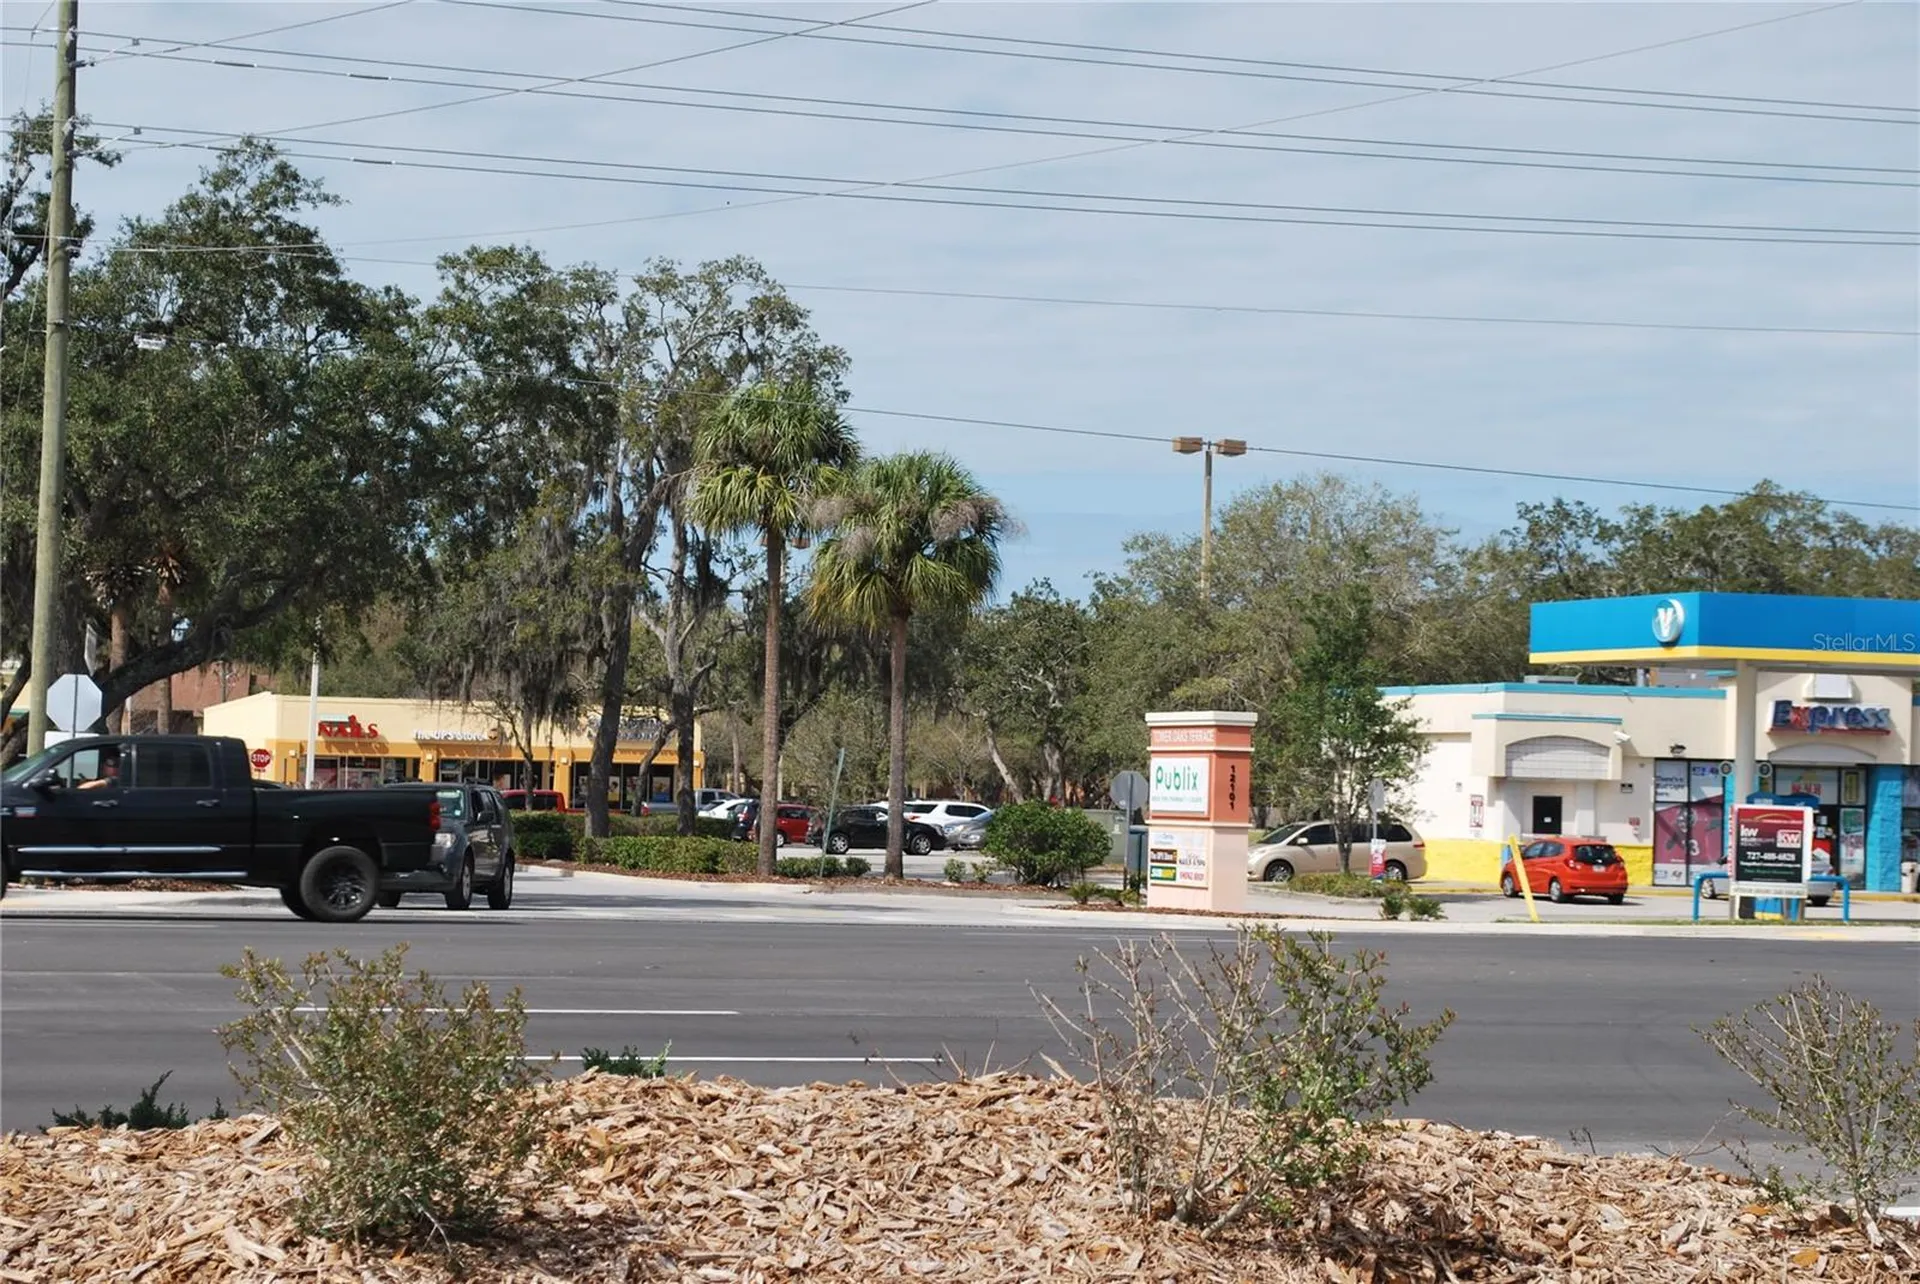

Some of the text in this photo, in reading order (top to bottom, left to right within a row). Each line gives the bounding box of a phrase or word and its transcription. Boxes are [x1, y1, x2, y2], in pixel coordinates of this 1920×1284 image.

[318, 714, 379, 738] NAILS
[1772, 699, 1891, 733] Express
[433, 730, 453, 741] UPS
[251, 754, 271, 763] STOP
[1155, 765, 1198, 791] Publix
[1228, 764, 1237, 811] 12101
